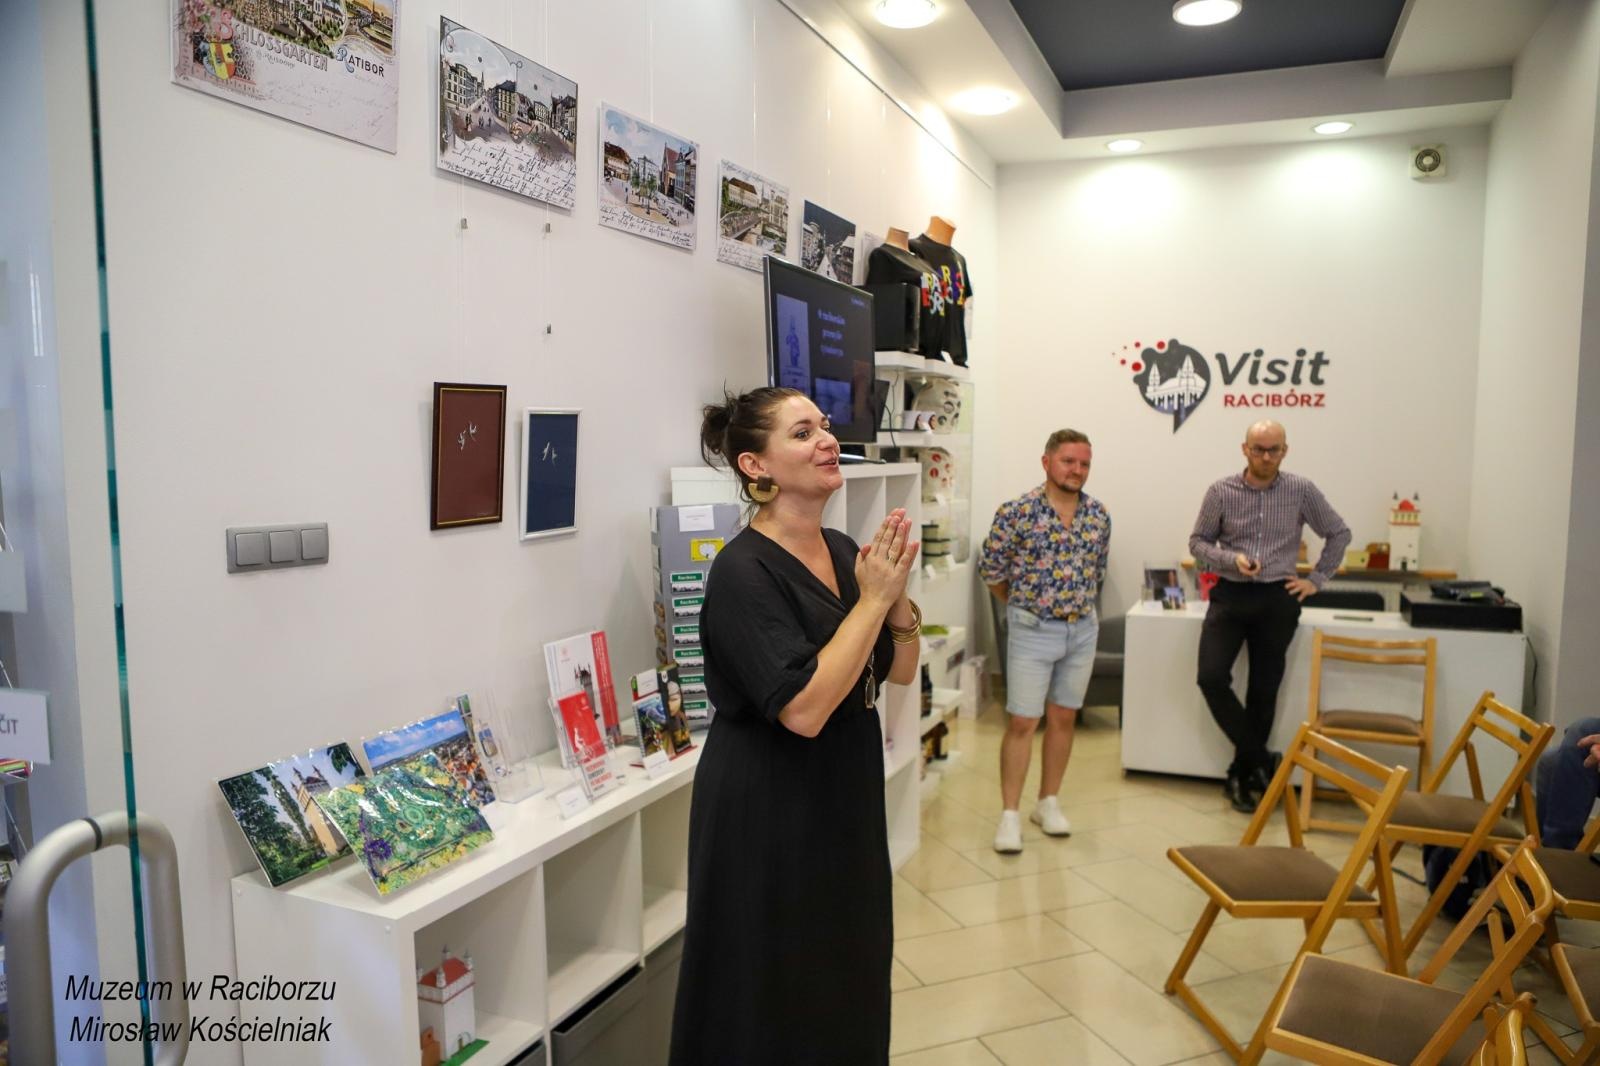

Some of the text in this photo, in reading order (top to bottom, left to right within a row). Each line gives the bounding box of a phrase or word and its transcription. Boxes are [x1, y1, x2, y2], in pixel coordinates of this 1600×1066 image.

[335, 44, 384, 77] RATIBOR
[1215, 348, 1330, 386] Visit
[1224, 388, 1326, 408] RACIBÓRZ
